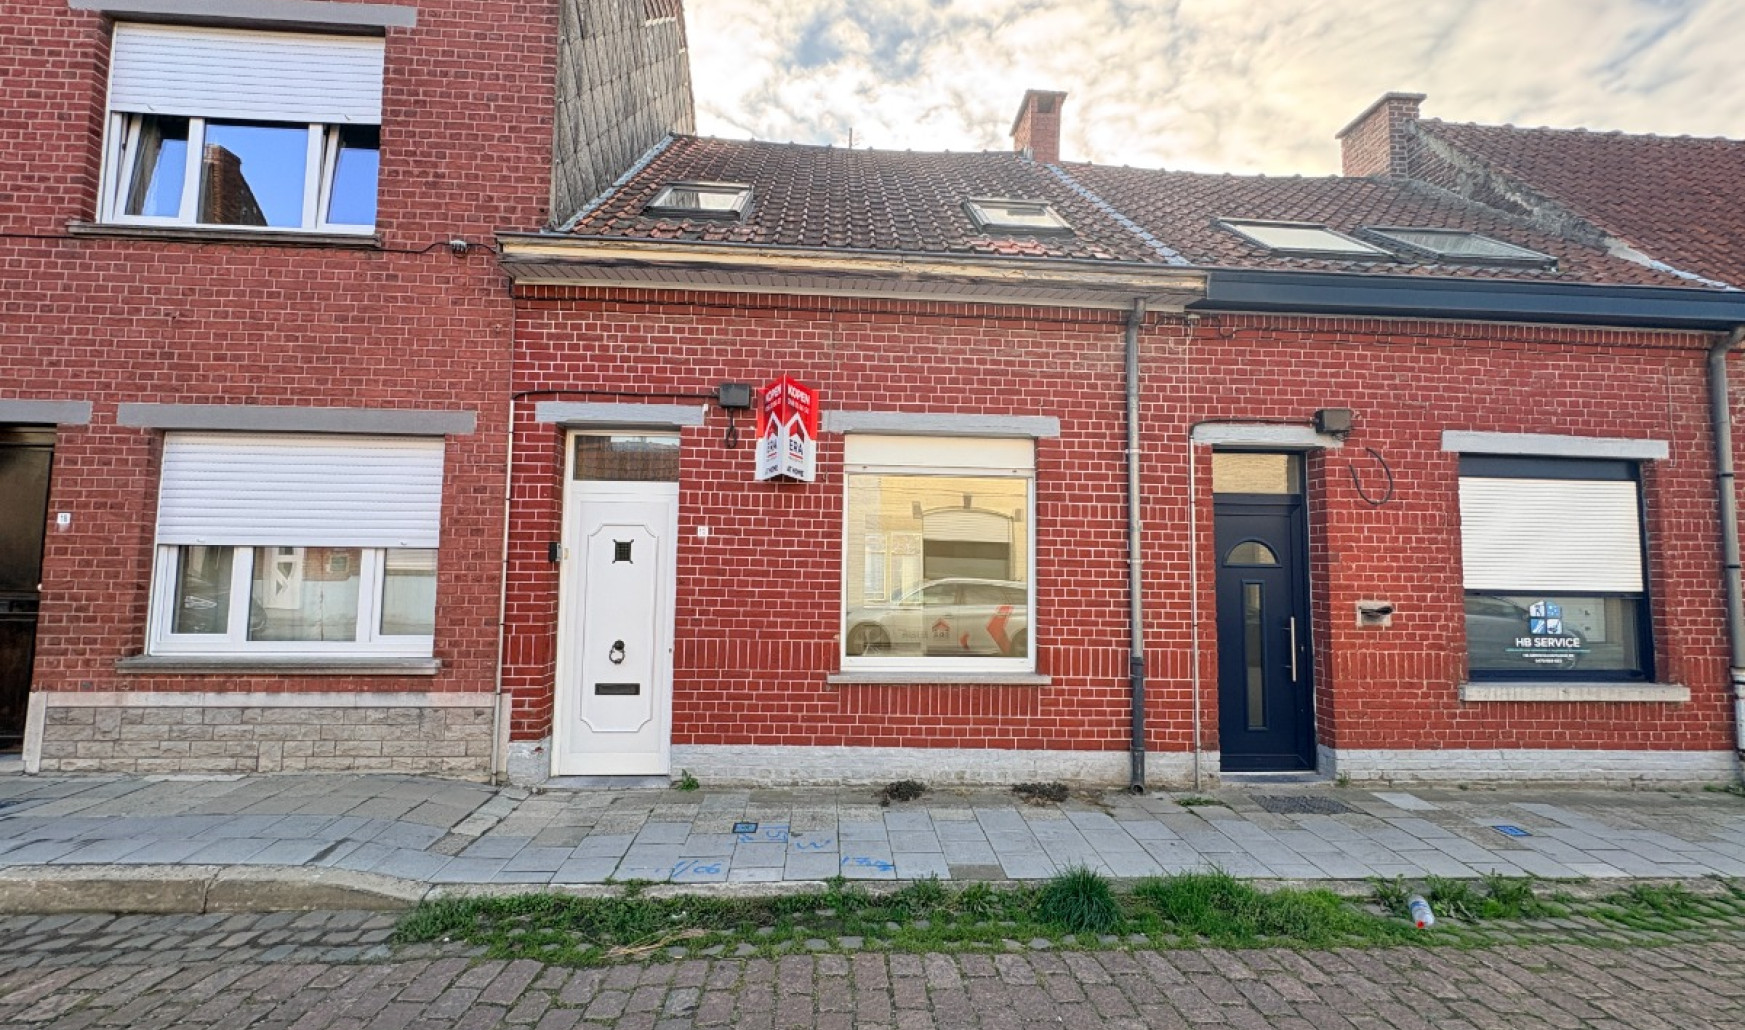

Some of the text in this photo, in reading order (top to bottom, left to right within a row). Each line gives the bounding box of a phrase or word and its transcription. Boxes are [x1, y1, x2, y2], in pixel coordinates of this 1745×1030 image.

[789, 438, 804, 455] ERA
[1515, 637, 1580, 648] HB SERVICE
